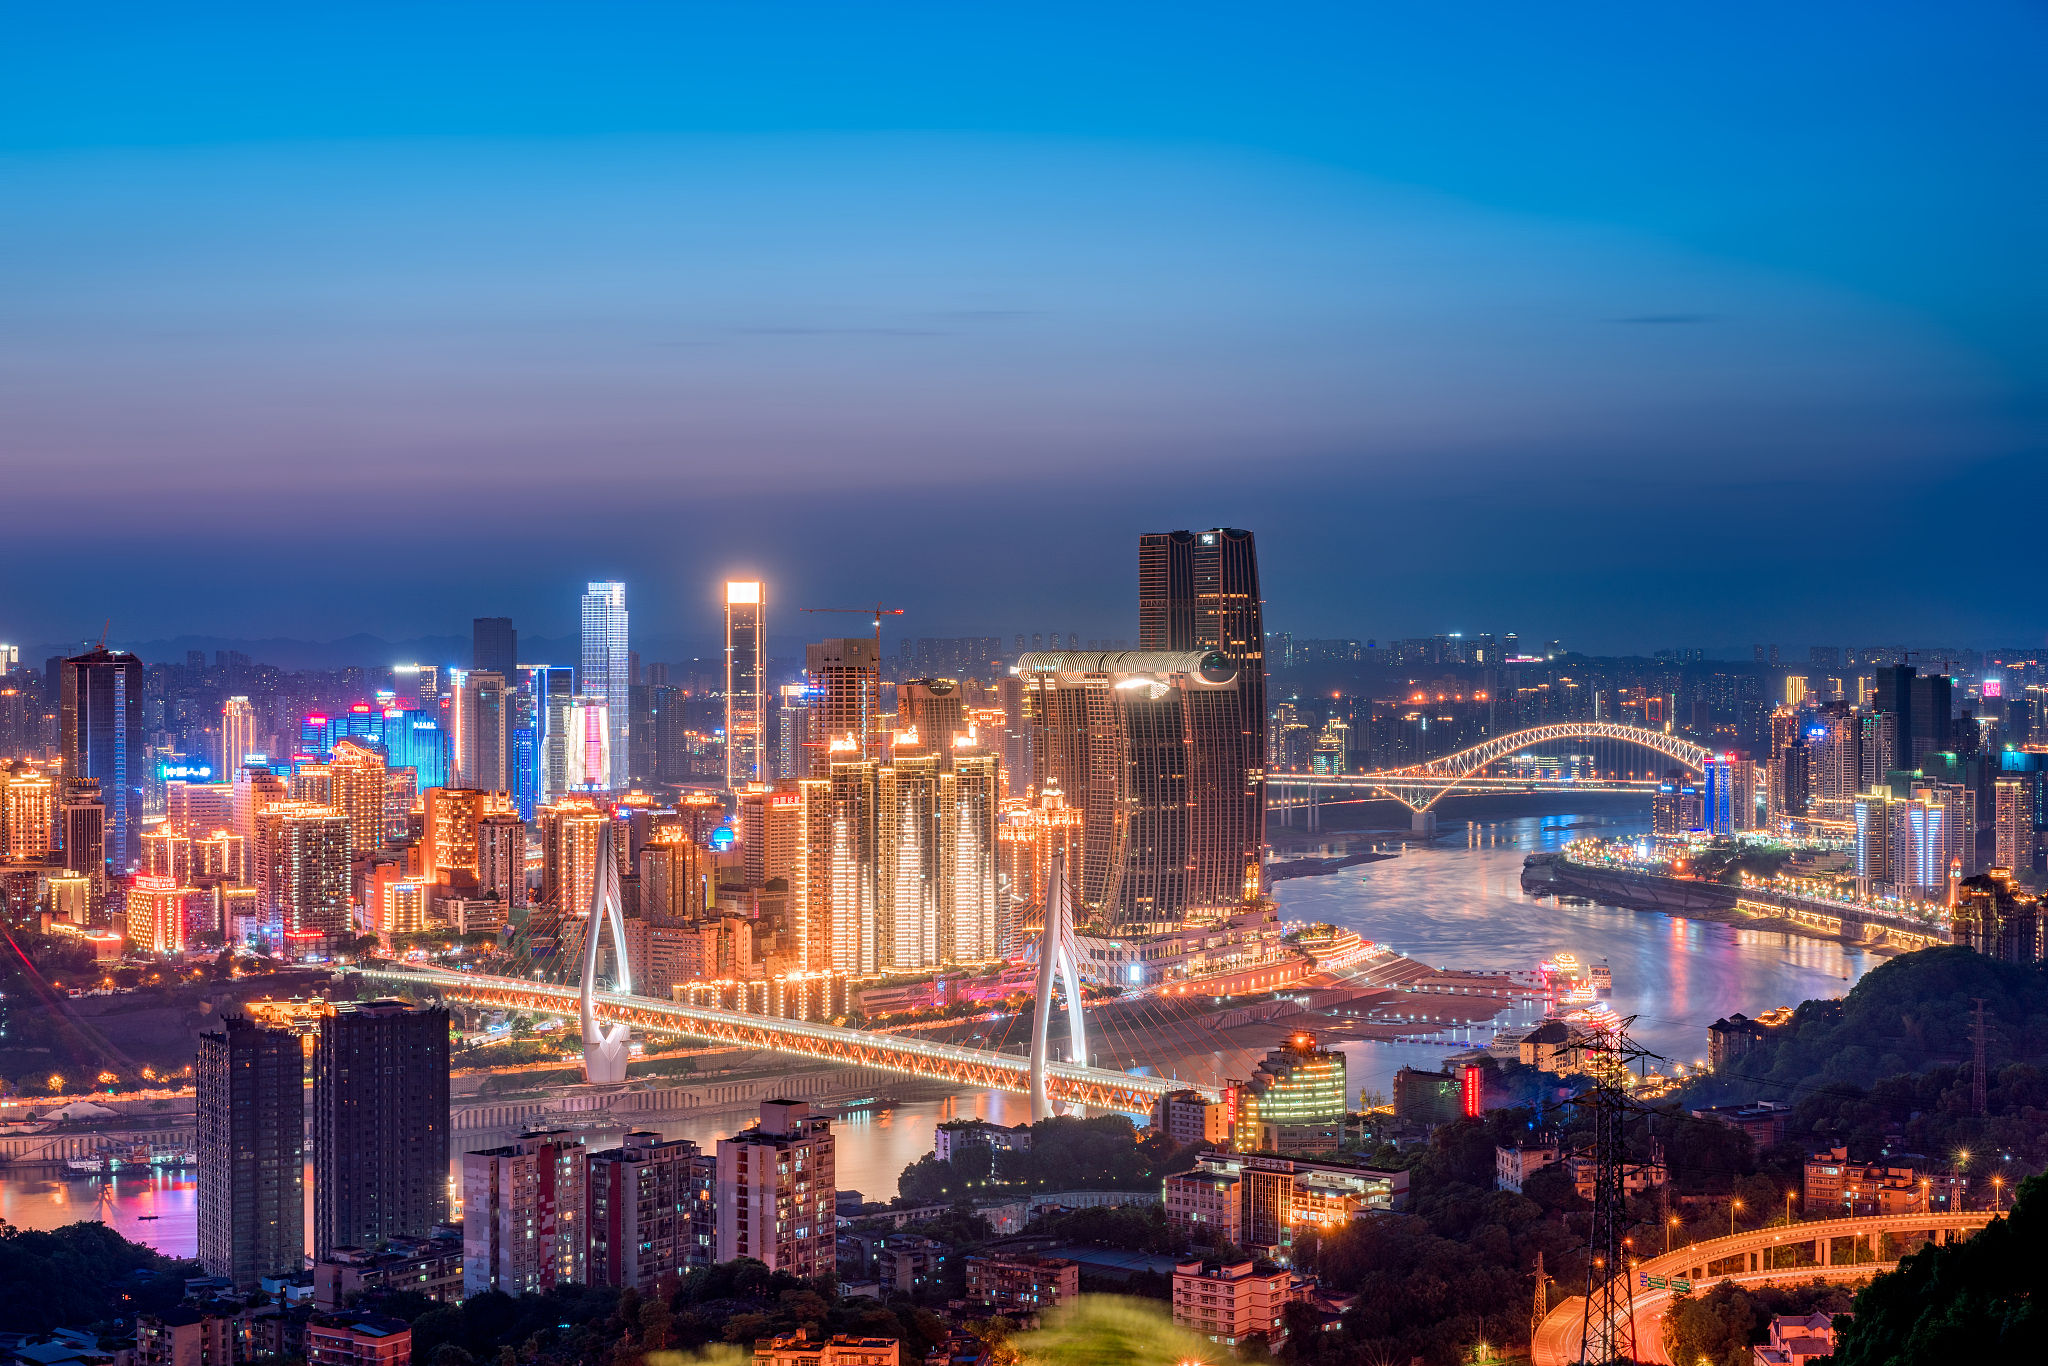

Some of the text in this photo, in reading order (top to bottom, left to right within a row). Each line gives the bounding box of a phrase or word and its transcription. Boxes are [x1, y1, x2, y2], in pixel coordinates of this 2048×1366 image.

[1242, 1156, 1291, 1171] 重庆三十九中
